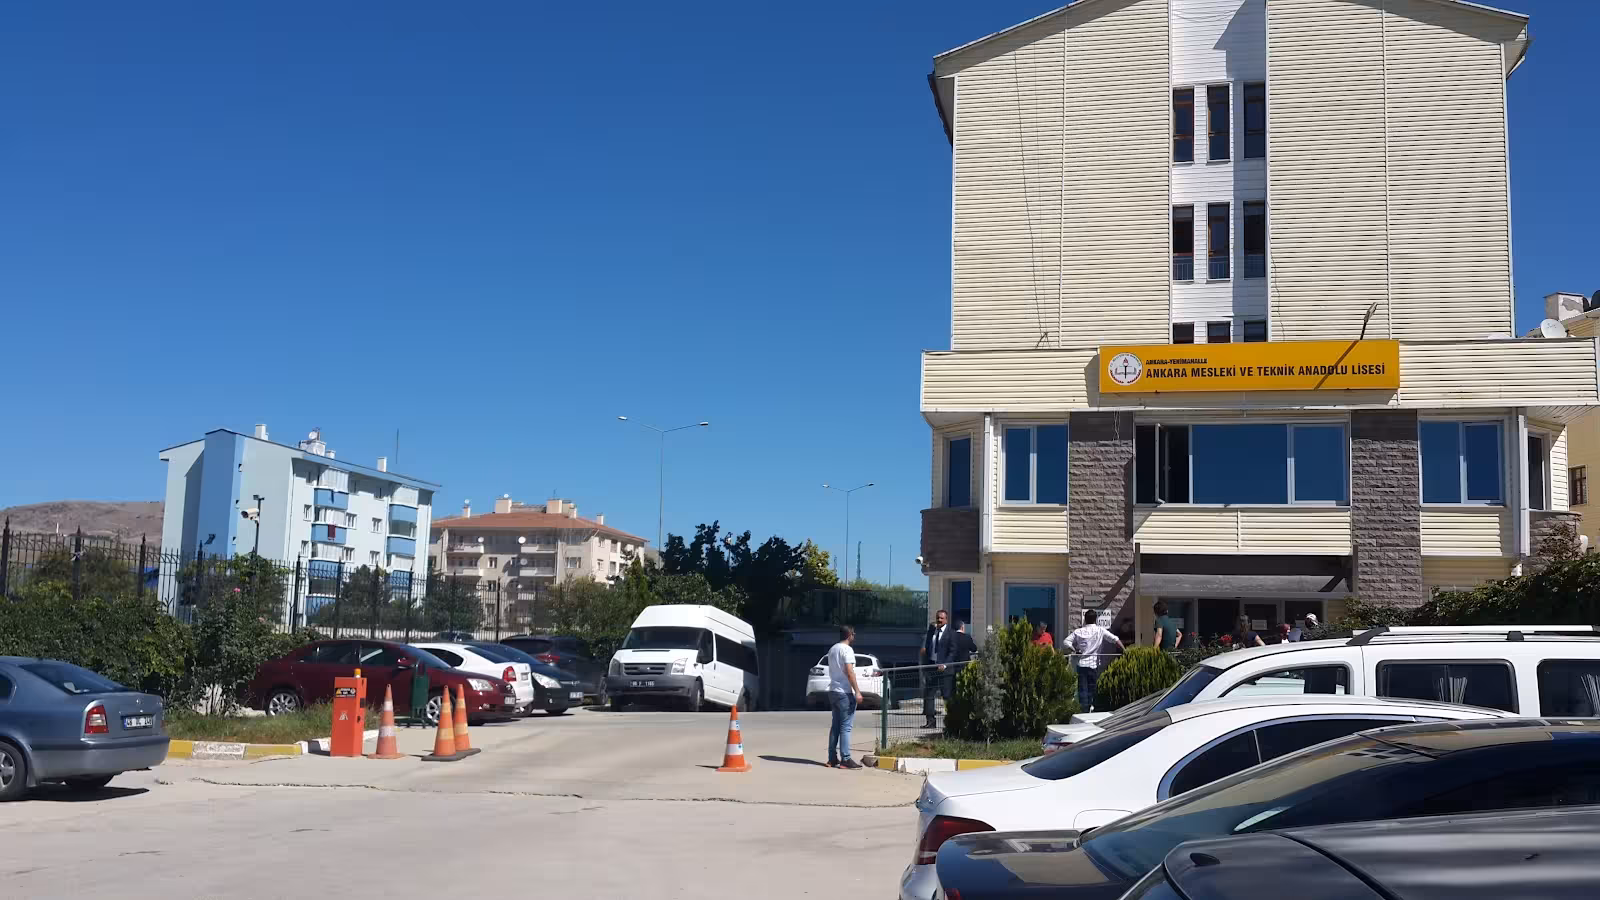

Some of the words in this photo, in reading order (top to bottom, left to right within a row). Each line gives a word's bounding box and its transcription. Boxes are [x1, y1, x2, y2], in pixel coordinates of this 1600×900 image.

[1146, 368, 1187, 378] ANKARA
[1191, 364, 1236, 377] MESLEKİ
[1240, 366, 1253, 376] VE
[1256, 363, 1295, 376] TEKNİK
[1298, 364, 1348, 376] ANADOLU
[1351, 362, 1385, 375] LİSESİ
